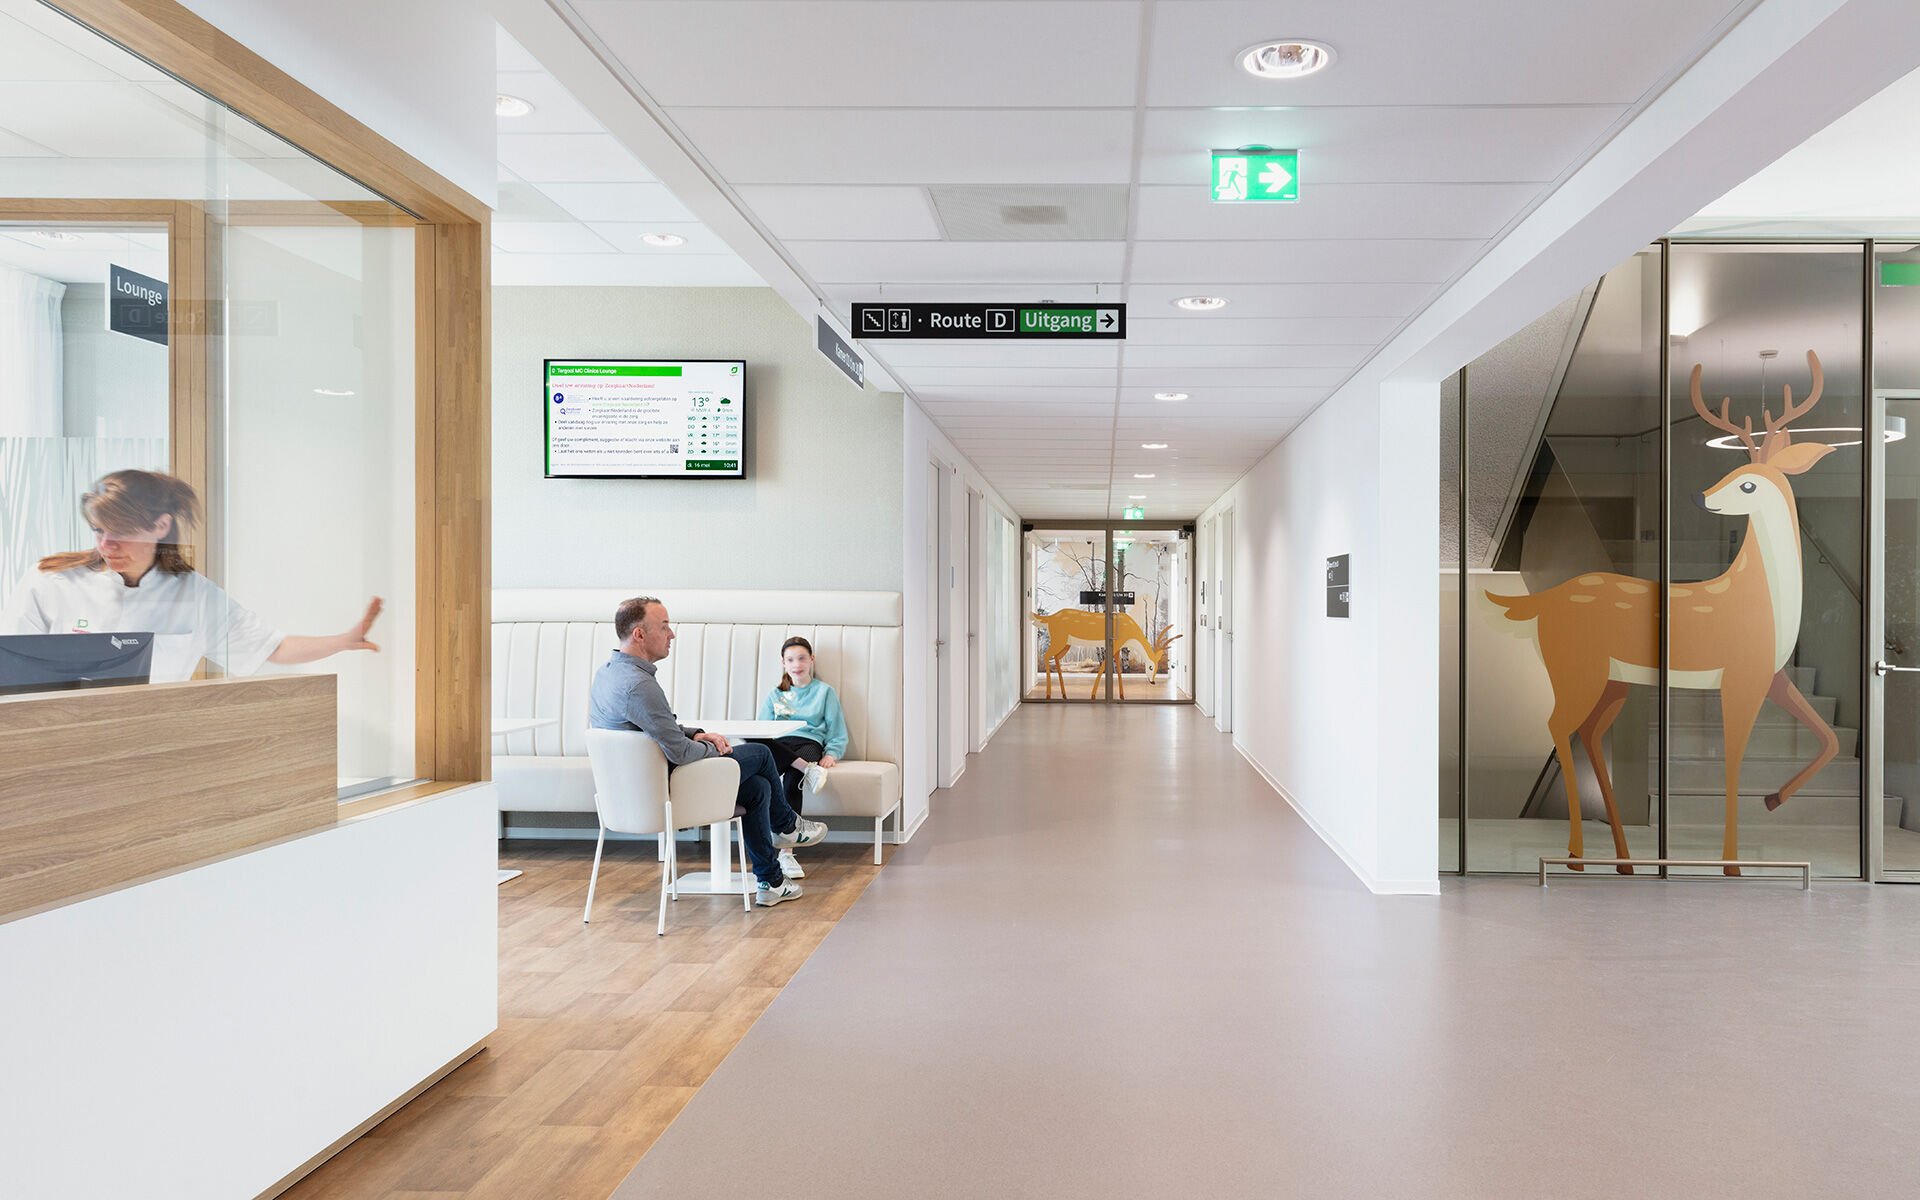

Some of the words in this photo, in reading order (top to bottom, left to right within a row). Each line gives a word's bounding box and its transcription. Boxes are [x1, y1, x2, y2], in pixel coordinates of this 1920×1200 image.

[117, 276, 162, 306] Lounge
[930, 312, 981, 328] Route
[995, 313, 1006, 328] D
[1025, 312, 1092, 331] Uitgang
